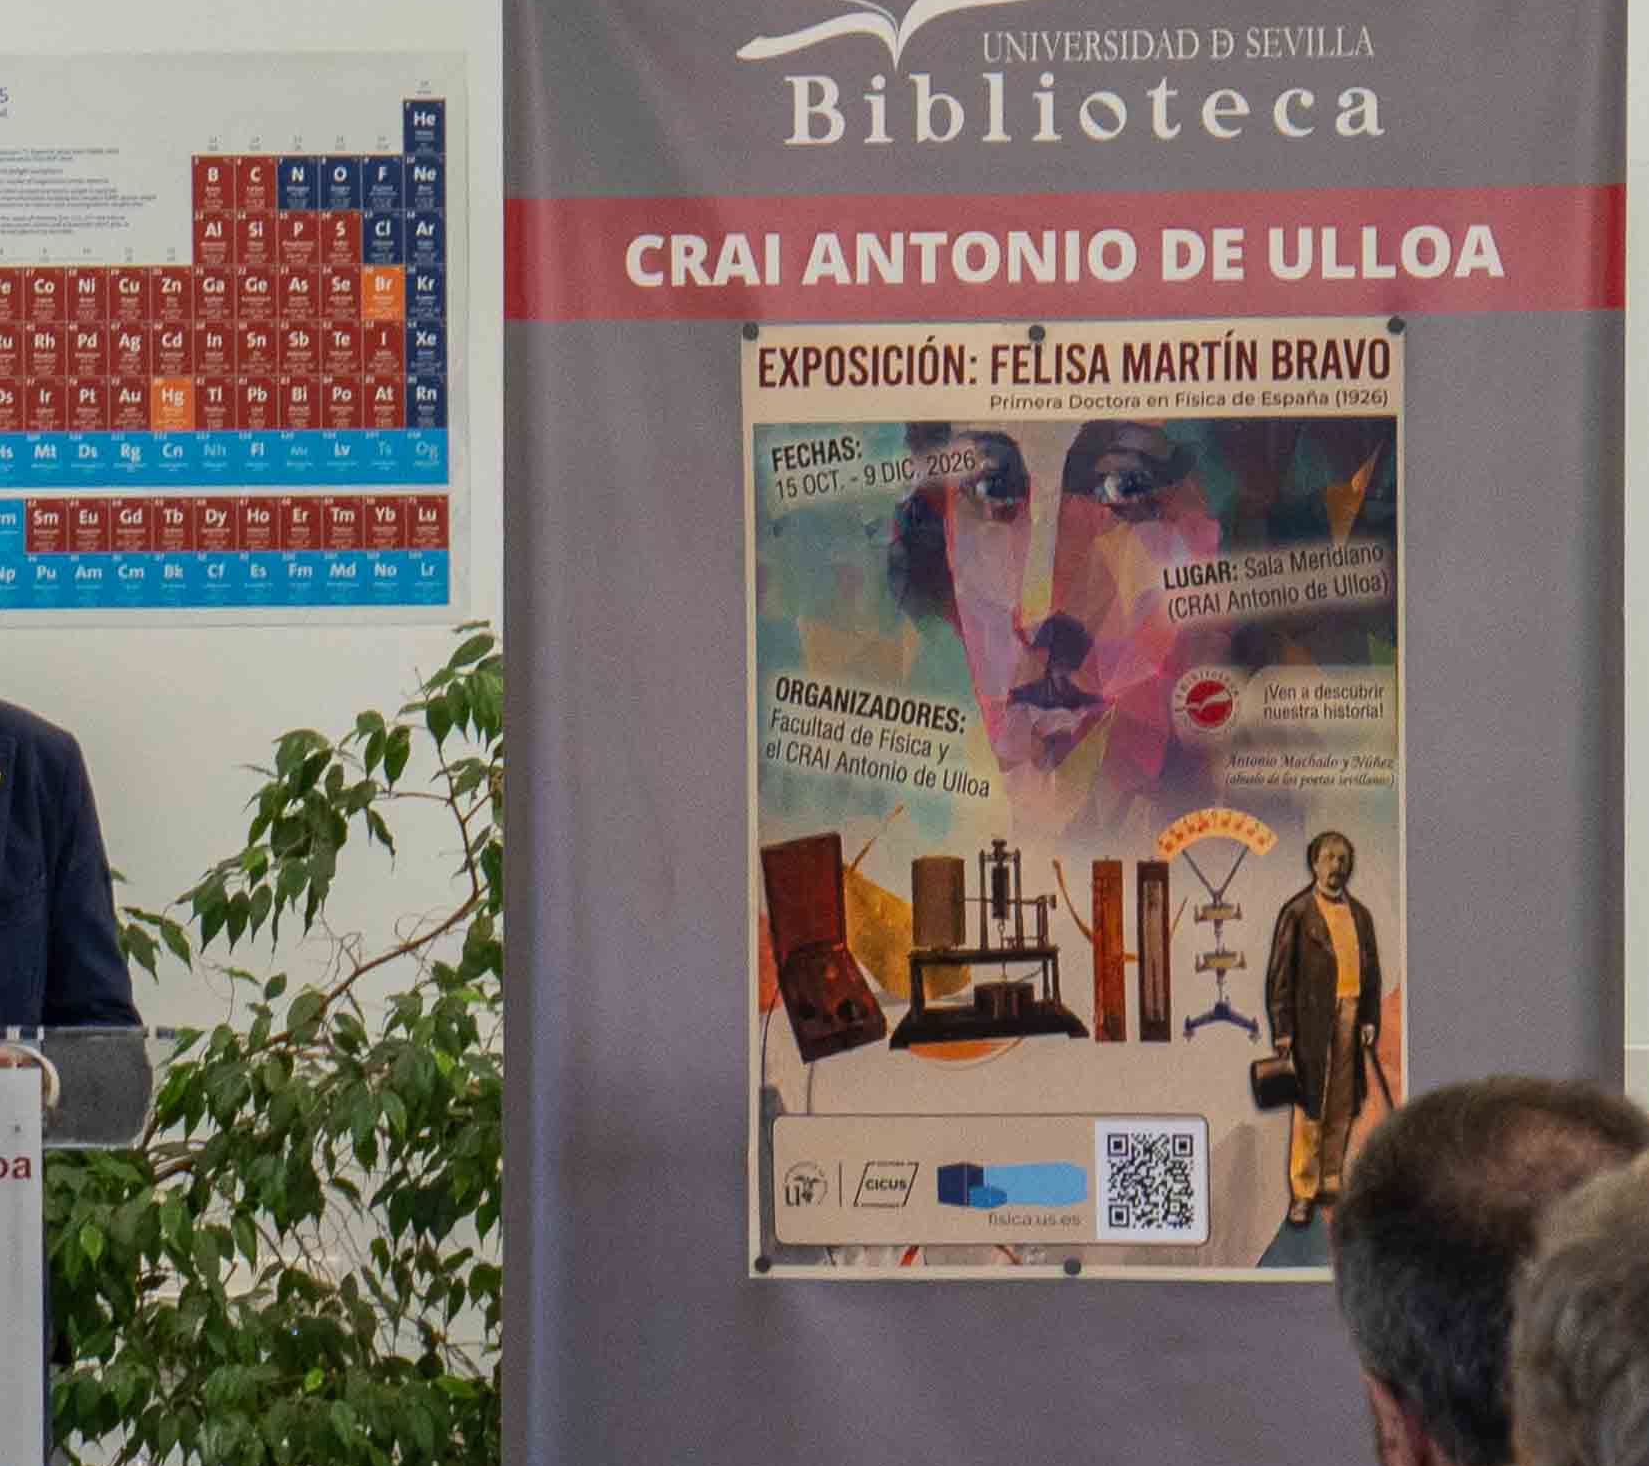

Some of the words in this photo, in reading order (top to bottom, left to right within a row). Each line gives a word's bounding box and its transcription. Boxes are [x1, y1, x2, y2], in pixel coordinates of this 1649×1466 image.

[982, 30, 1200, 64] UNIVERSIDAD
[1245, 25, 1375, 58] SEVILLA
[413, 111, 436, 127] He
[783, 72, 1385, 146] Biblioteca
[207, 166, 219, 183] B
[249, 166, 261, 183] C
[291, 166, 304, 182] N
[333, 166, 347, 182] O
[377, 166, 387, 182] F
[413, 166, 437, 182] Ne
[204, 221, 222, 238] Al
[248, 220, 264, 238] Si
[293, 221, 304, 237] P
[335, 220, 346, 237] S
[374, 220, 391, 237] Cl
[415, 220, 435, 237] Ar
[625, 233, 782, 289] CRAI
[802, 228, 1138, 287] ANTONIO
[1162, 226, 1244, 282] DE
[1267, 223, 1505, 281] ULLOA
[33, 278, 55, 294] Co
[78, 277, 96, 294] Ni
[118, 277, 140, 294] Cu
[161, 277, 182, 293] Zn
[202, 276, 225, 293] Ga
[245, 276, 268, 293] Ge
[288, 276, 309, 293] As
[331, 276, 351, 292] Se
[374, 275, 393, 292] Br
[417, 275, 435, 291] Kr
[34, 332, 56, 349] Rh
[77, 332, 98, 349] Pd
[118, 332, 141, 354] Ag
[161, 331, 183, 348] Cd
[206, 332, 223, 348] In
[246, 331, 267, 348] Sn
[288, 330, 310, 348] Sb
[332, 330, 351, 347] Te
[380, 330, 387, 347] I
[415, 331, 437, 347] Xe
[758, 335, 978, 388] EXPOSICIÓN:
[990, 342, 1111, 386] FELISA
[1122, 329, 1258, 383] MARTÍN
[1271, 338, 1390, 381] BRAVO
[990, 394, 1062, 410] Primera
[1069, 392, 1141, 410] Doctora
[1147, 395, 1169, 408] en
[1175, 390, 1225, 408] Física
[1232, 390, 1255, 406] de
[1261, 390, 1329, 409] España
[1335, 388, 1389, 408] (1926)
[771, 435, 862, 473] FECHAS:
[776, 478, 798, 500] 15
[863, 465, 876, 485] 9
[1163, 560, 1238, 590] LUGAR:
[1244, 554, 1284, 579] Sala
[1289, 542, 1384, 573] Meridiano
[1167, 594, 1220, 623] (CRAI
[1227, 587, 1300, 612] Antonio
[1305, 578, 1328, 600] de
[1334, 569, 1390, 597] Ulloa)
[775, 675, 967, 734] ORGANIZADORES:
[1263, 703, 1320, 720] nuestra
[1323, 702, 1384, 720] historia!
[1300, 687, 1310, 699] a
[1314, 684, 1385, 701] descubrir
[770, 708, 846, 743] Facultad
[851, 724, 873, 749] de
[879, 726, 931, 757] Física
[936, 742, 951, 766] y
[765, 740, 782, 760] el
[785, 741, 831, 770] CRAI
[834, 751, 908, 784] Antonio
[913, 765, 936, 788] de
[942, 768, 991, 799] Ulloa
